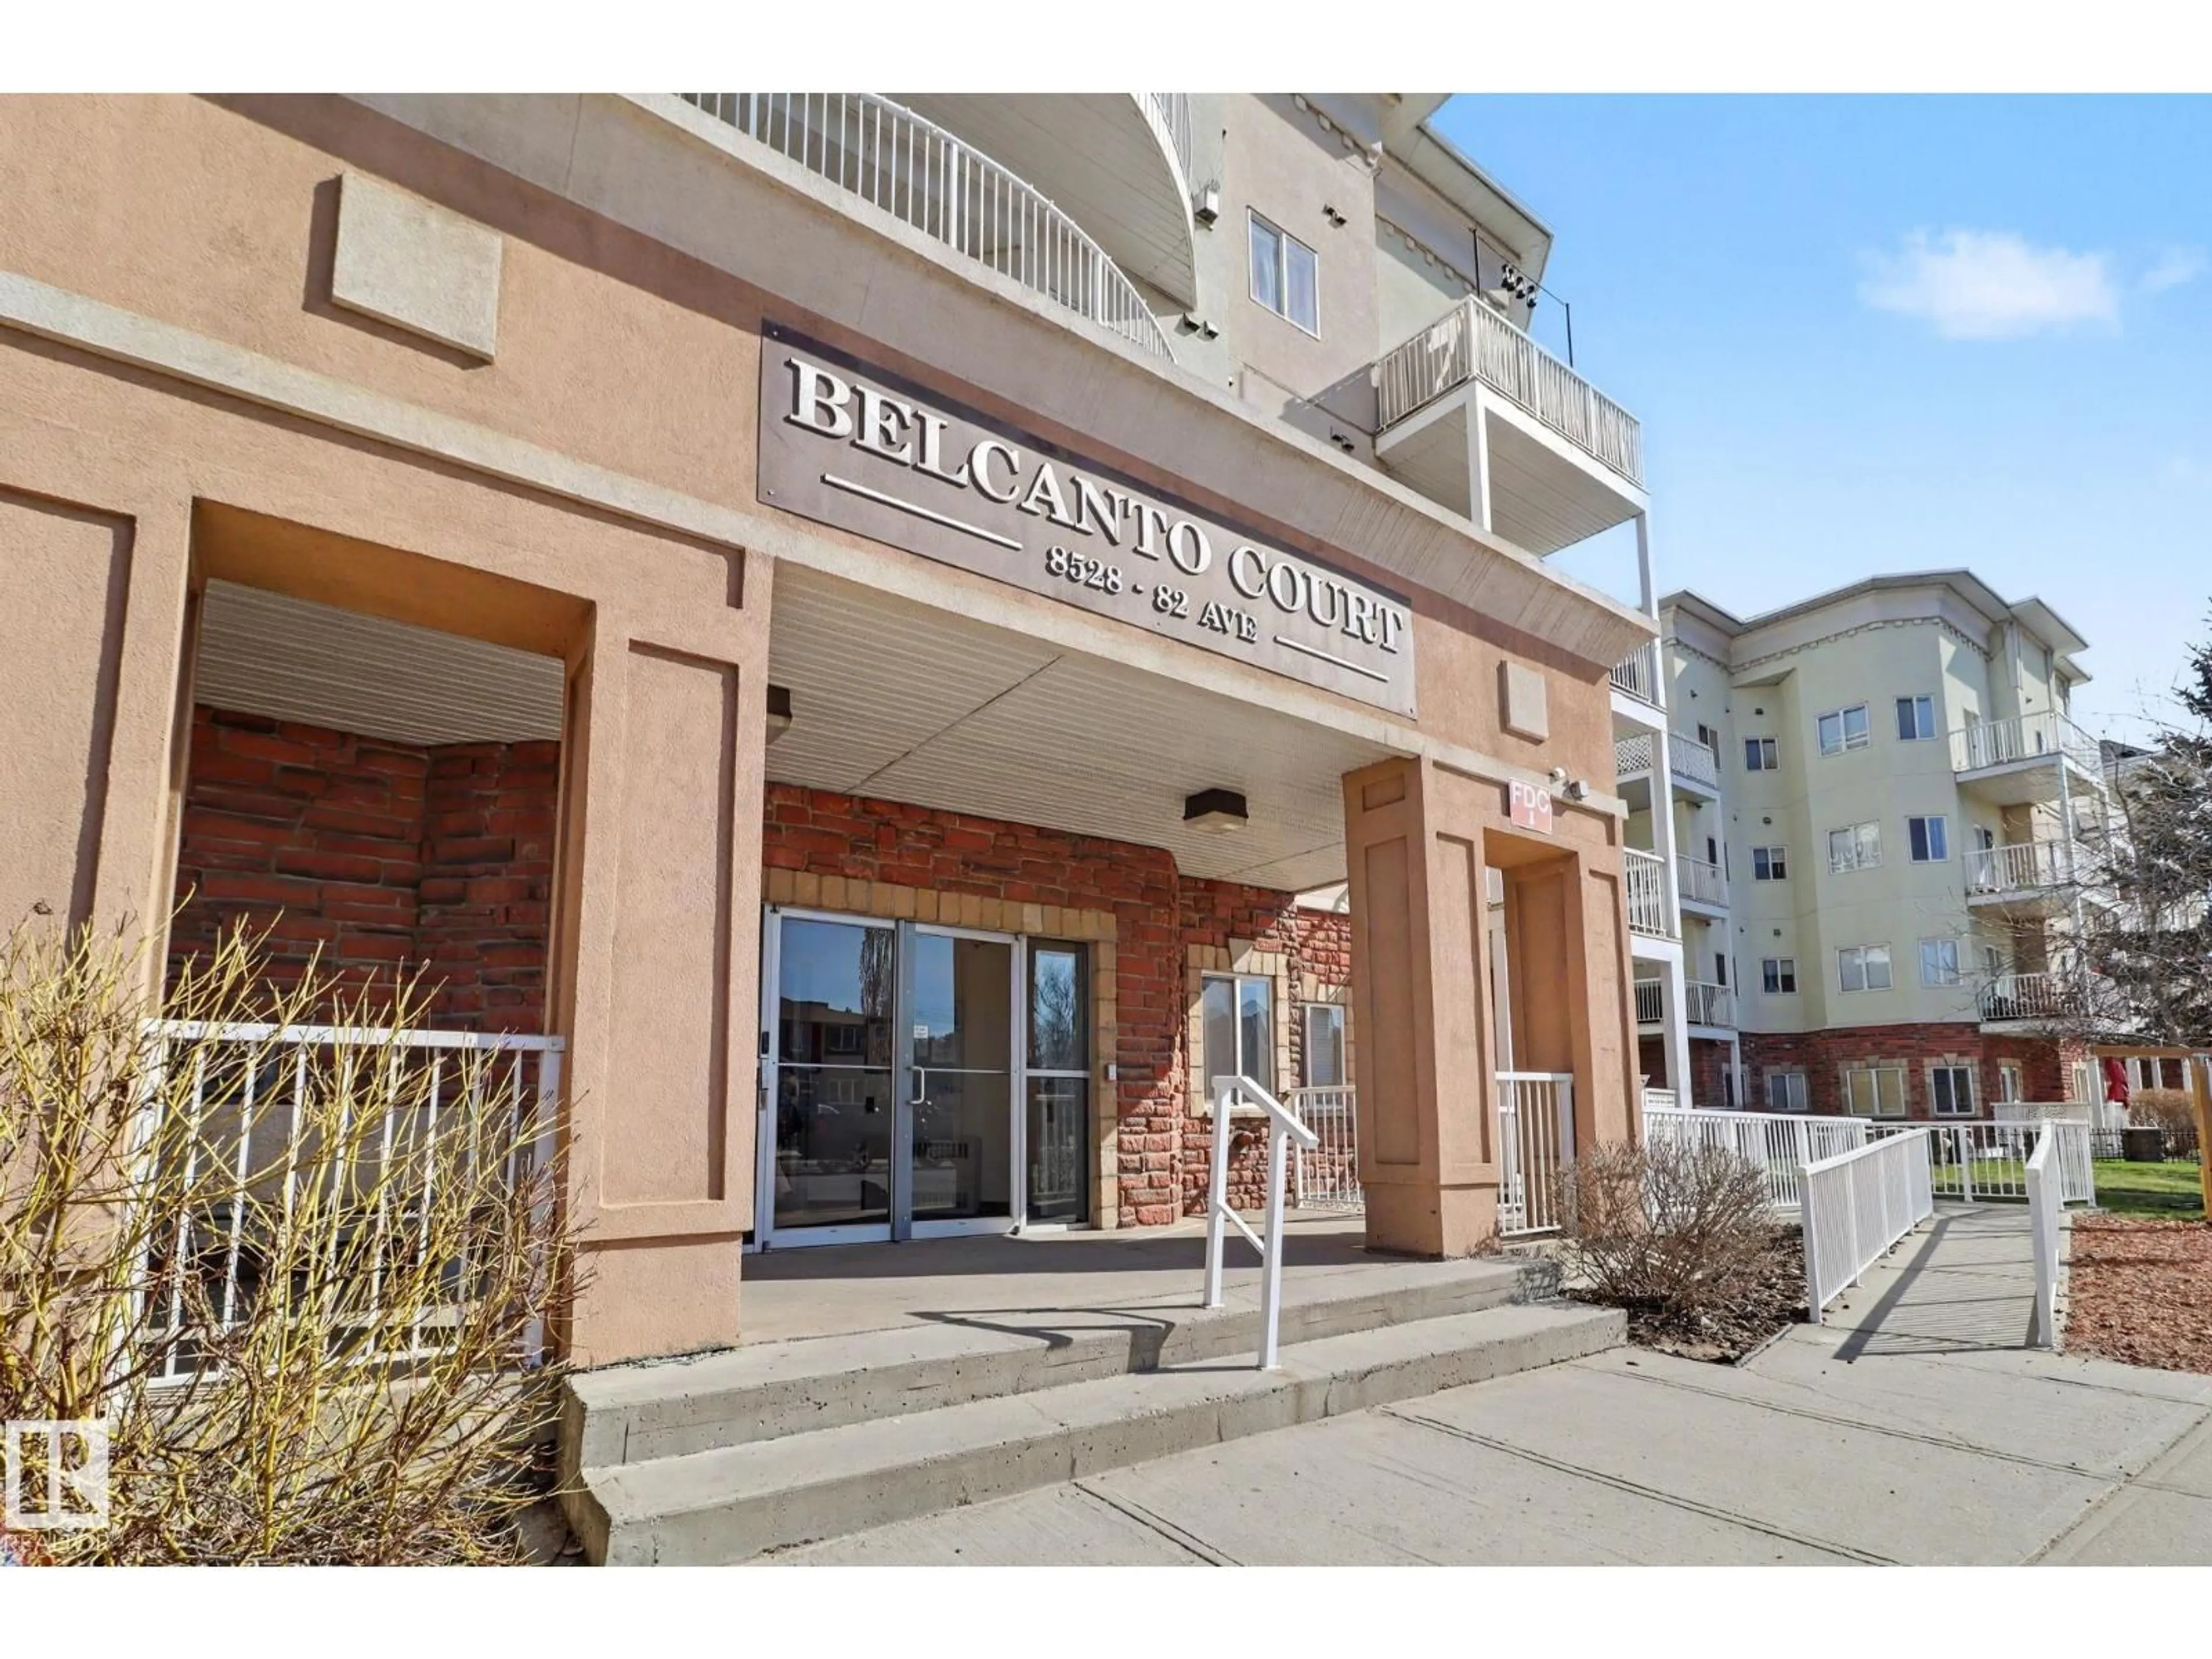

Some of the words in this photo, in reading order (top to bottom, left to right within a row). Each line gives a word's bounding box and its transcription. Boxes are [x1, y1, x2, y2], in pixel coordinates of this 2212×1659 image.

[786, 357, 1212, 575] BELCANTO
[1230, 545, 1403, 653] COURT
[1046, 546, 1123, 593] 8528
[1153, 584, 1190, 617] 82
[1199, 601, 1258, 642] AVE
[1512, 782, 1550, 814] FDC
